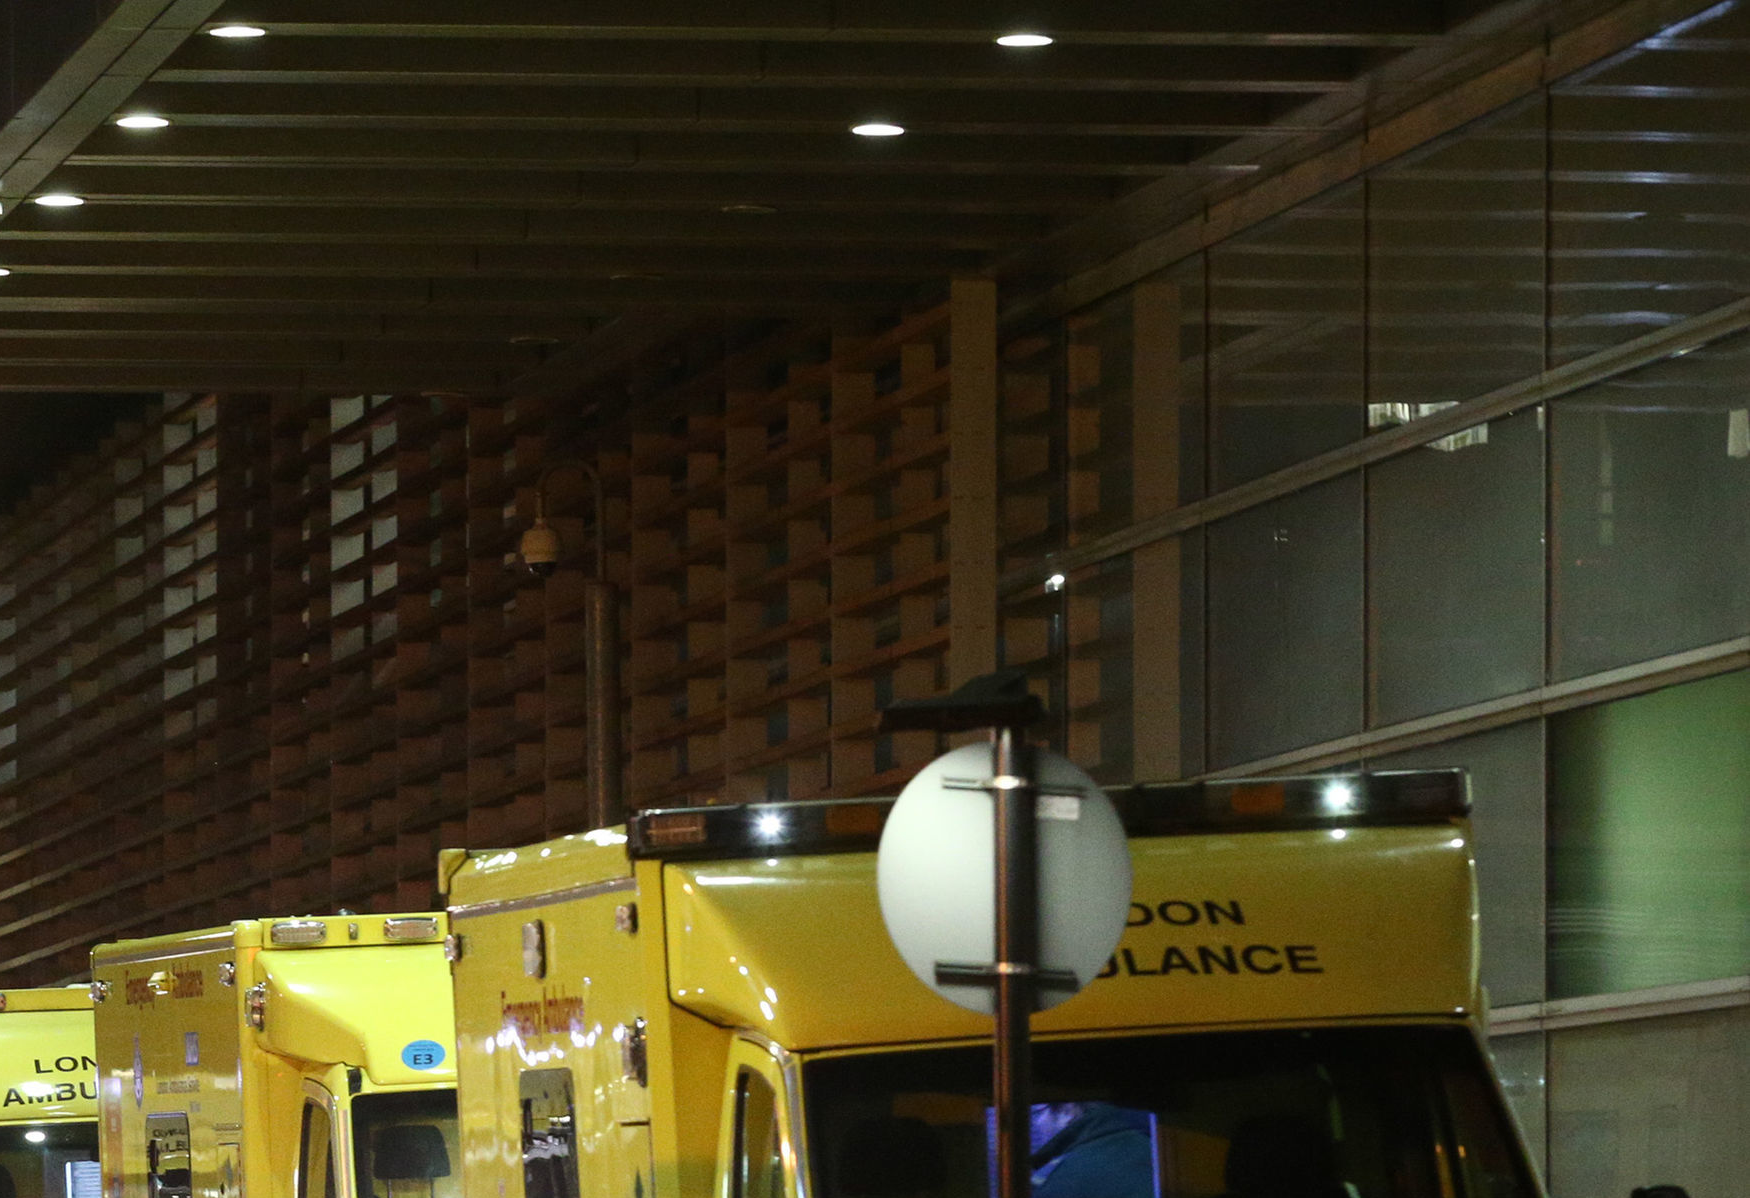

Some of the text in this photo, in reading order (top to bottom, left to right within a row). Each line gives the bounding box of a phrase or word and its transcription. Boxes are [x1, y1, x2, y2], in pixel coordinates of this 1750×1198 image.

[1126, 900, 1246, 928] DON
[33, 1055, 99, 1074] LON
[413, 1053, 434, 1065] E3
